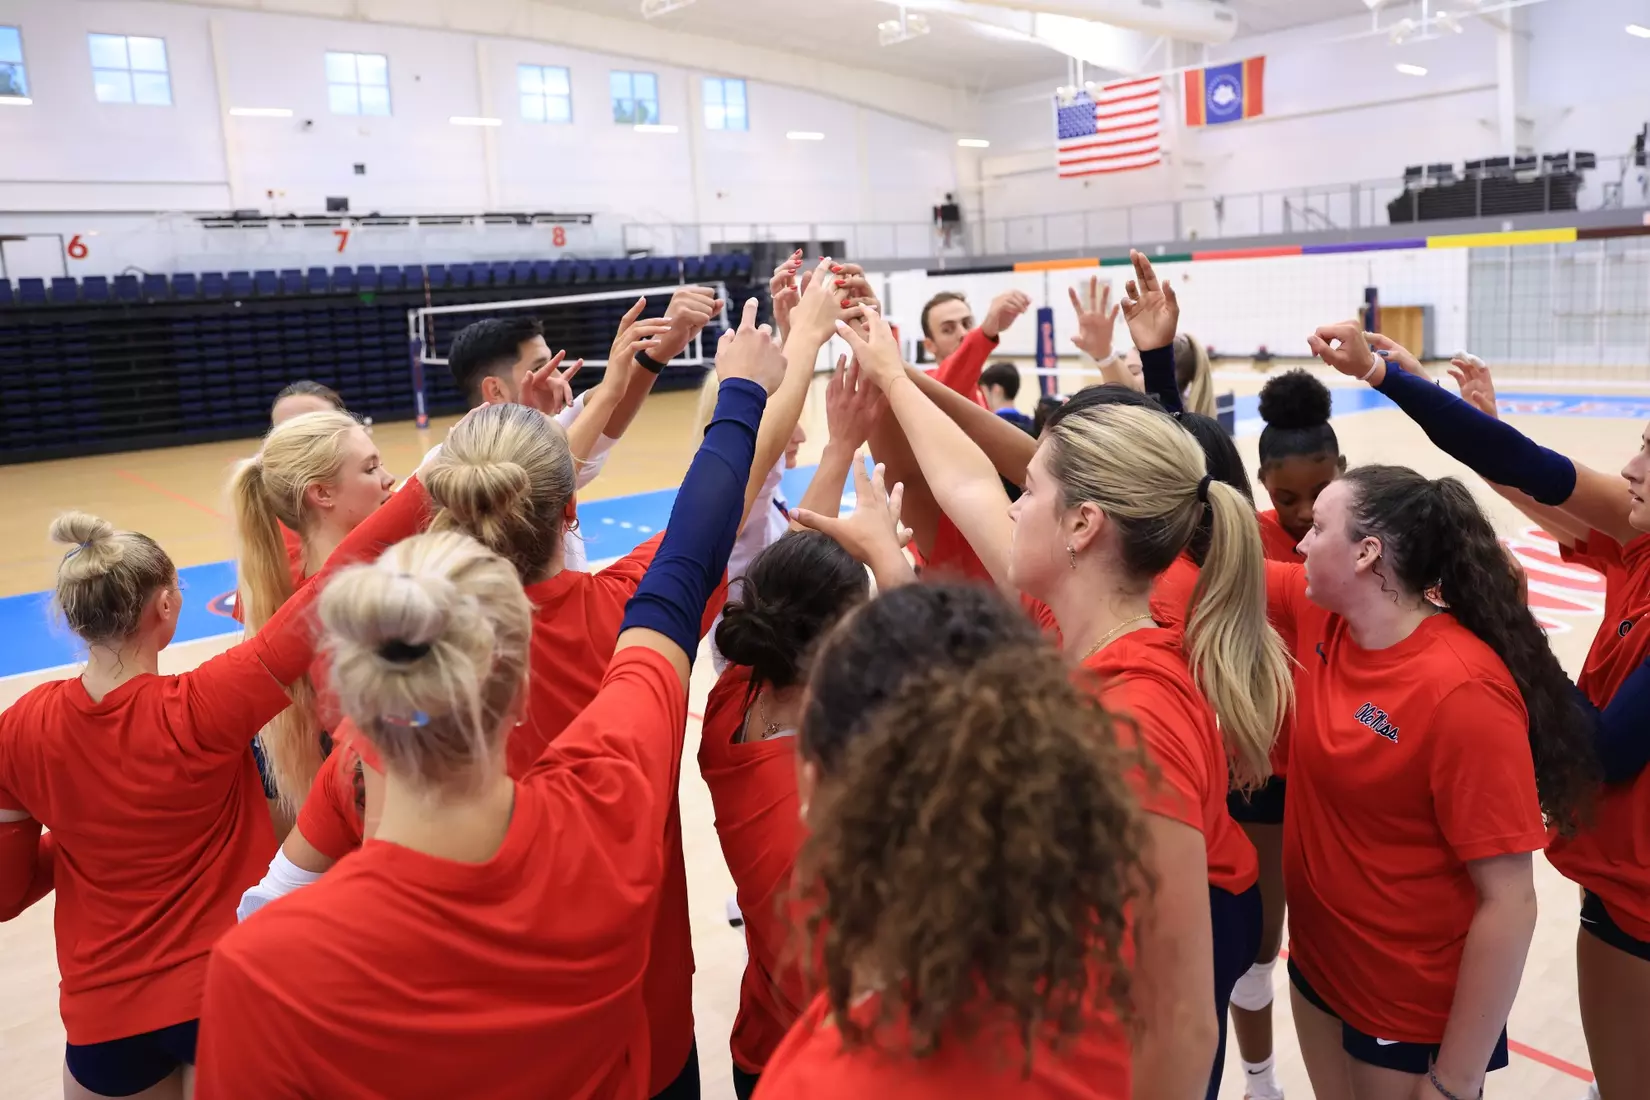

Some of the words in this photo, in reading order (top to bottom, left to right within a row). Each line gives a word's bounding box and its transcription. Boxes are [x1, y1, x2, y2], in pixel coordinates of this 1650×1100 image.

[68, 234, 88, 259] 6
[333, 229, 350, 253] 7
[552, 225, 567, 247] 8
[1354, 701, 1376, 726] Ole
[1369, 709, 1399, 741] Miss
